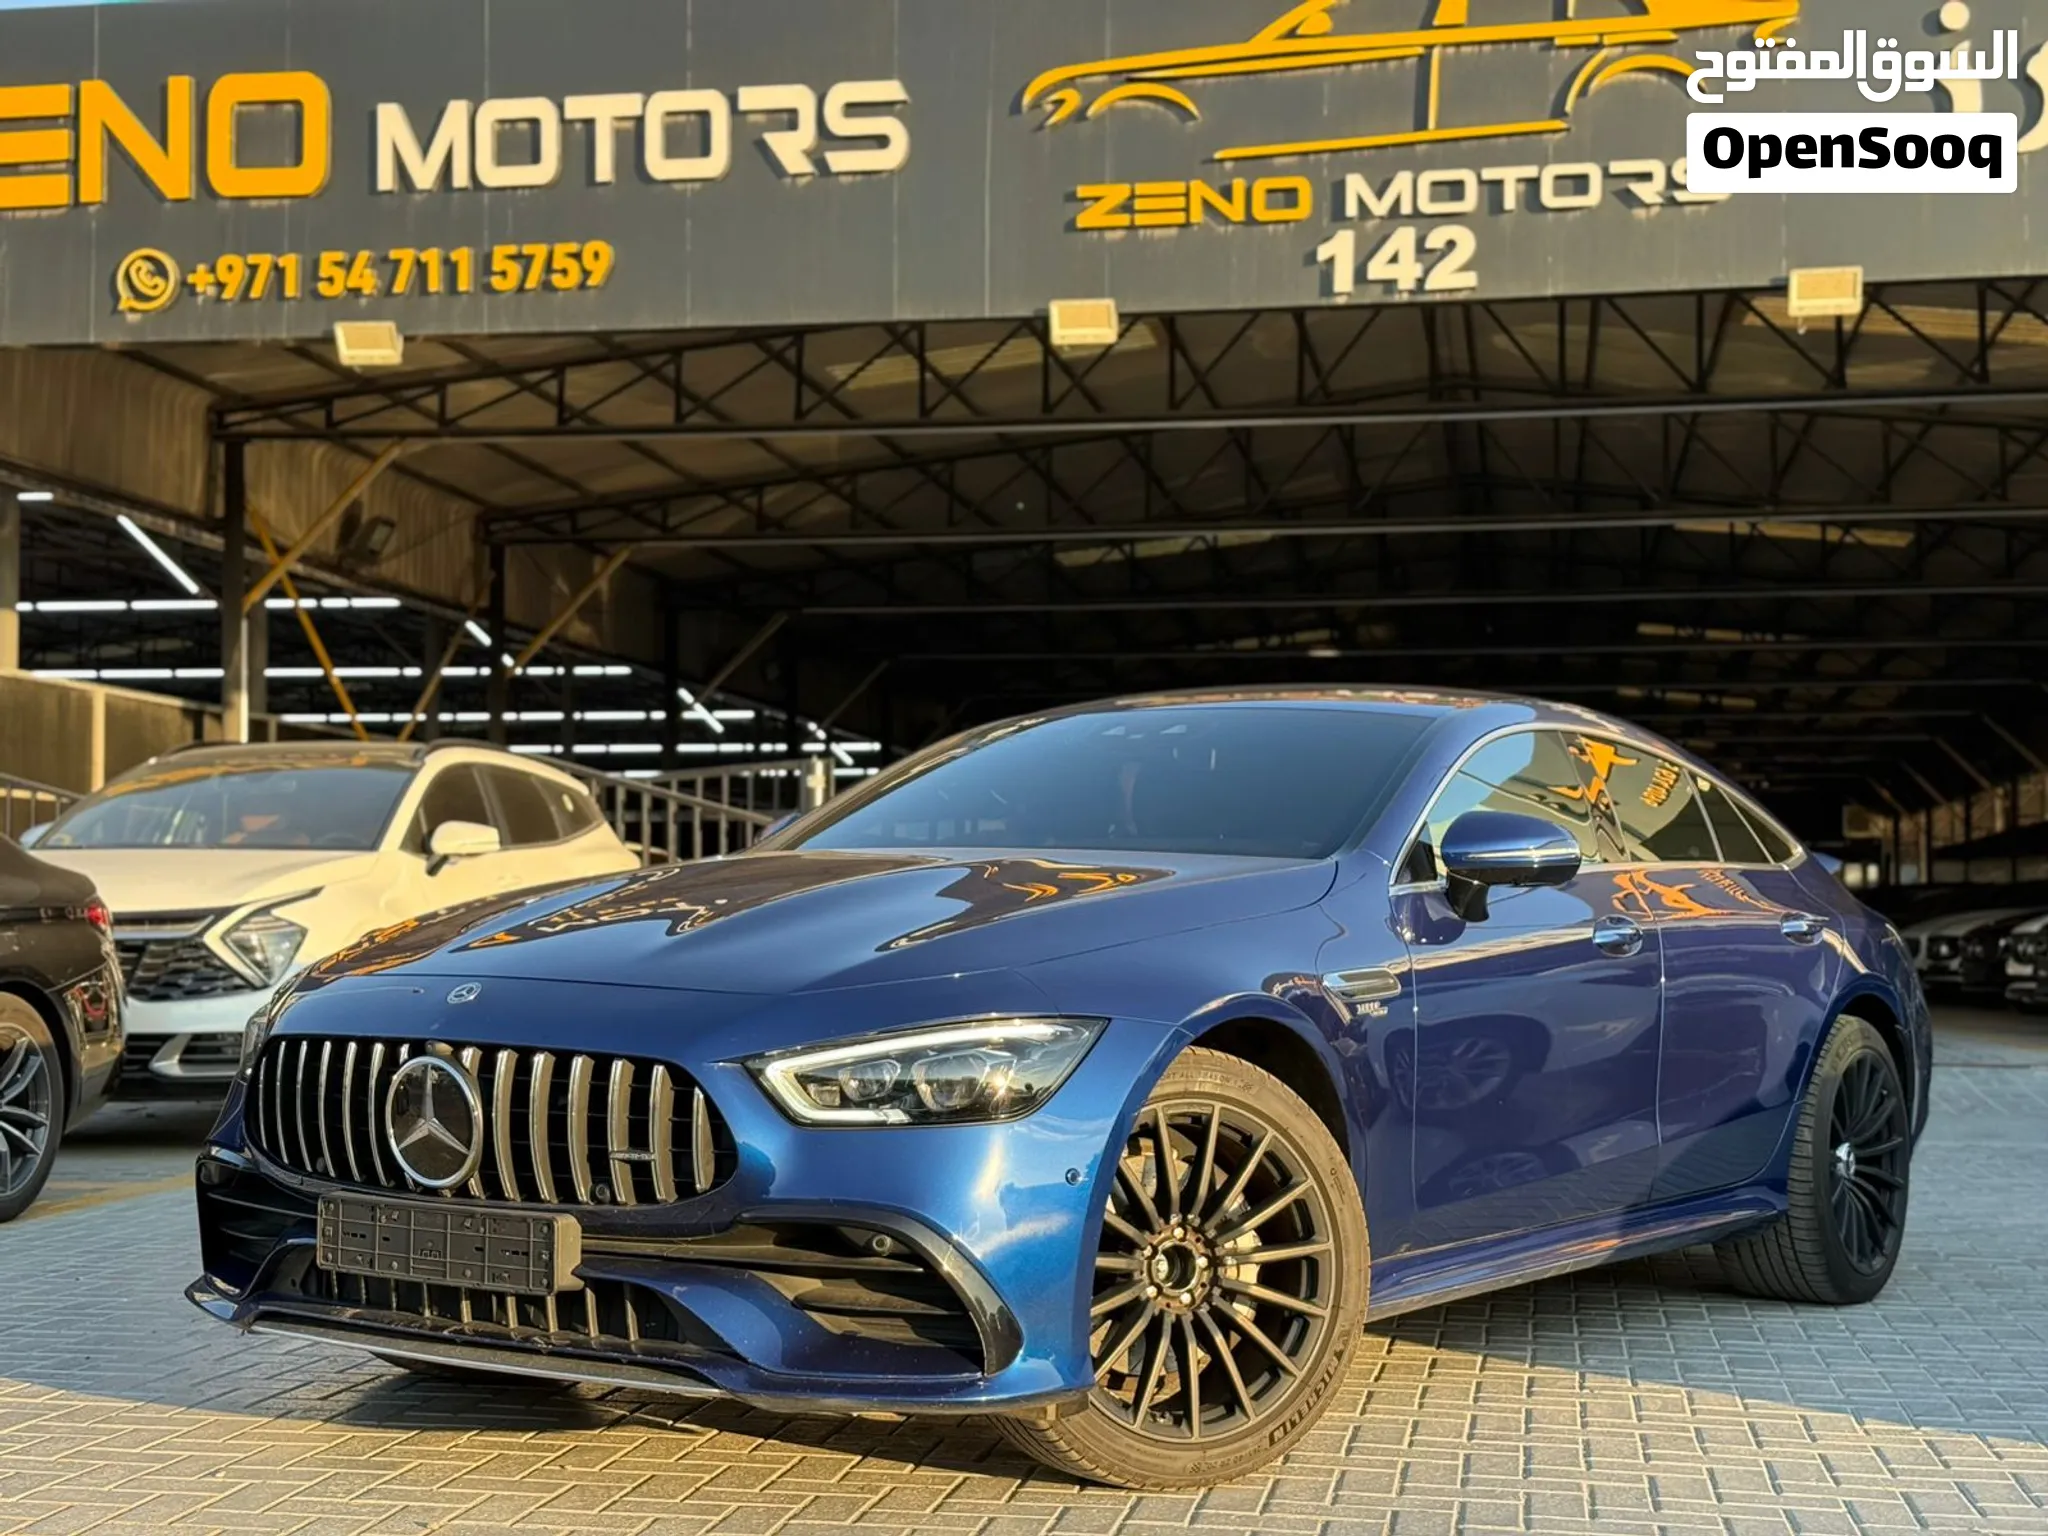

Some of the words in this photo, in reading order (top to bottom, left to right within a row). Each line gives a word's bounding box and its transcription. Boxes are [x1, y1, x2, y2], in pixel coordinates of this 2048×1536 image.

[376, 79, 911, 192] MOTORS
[1076, 175, 1313, 228] ZENO
[186, 254, 299, 299] +971
[317, 250, 376, 297] 54
[388, 246, 474, 294] 711
[489, 240, 614, 292] 5759
[1316, 224, 1478, 293] 142
[1269, 1350, 1344, 1446] MICHELIN
